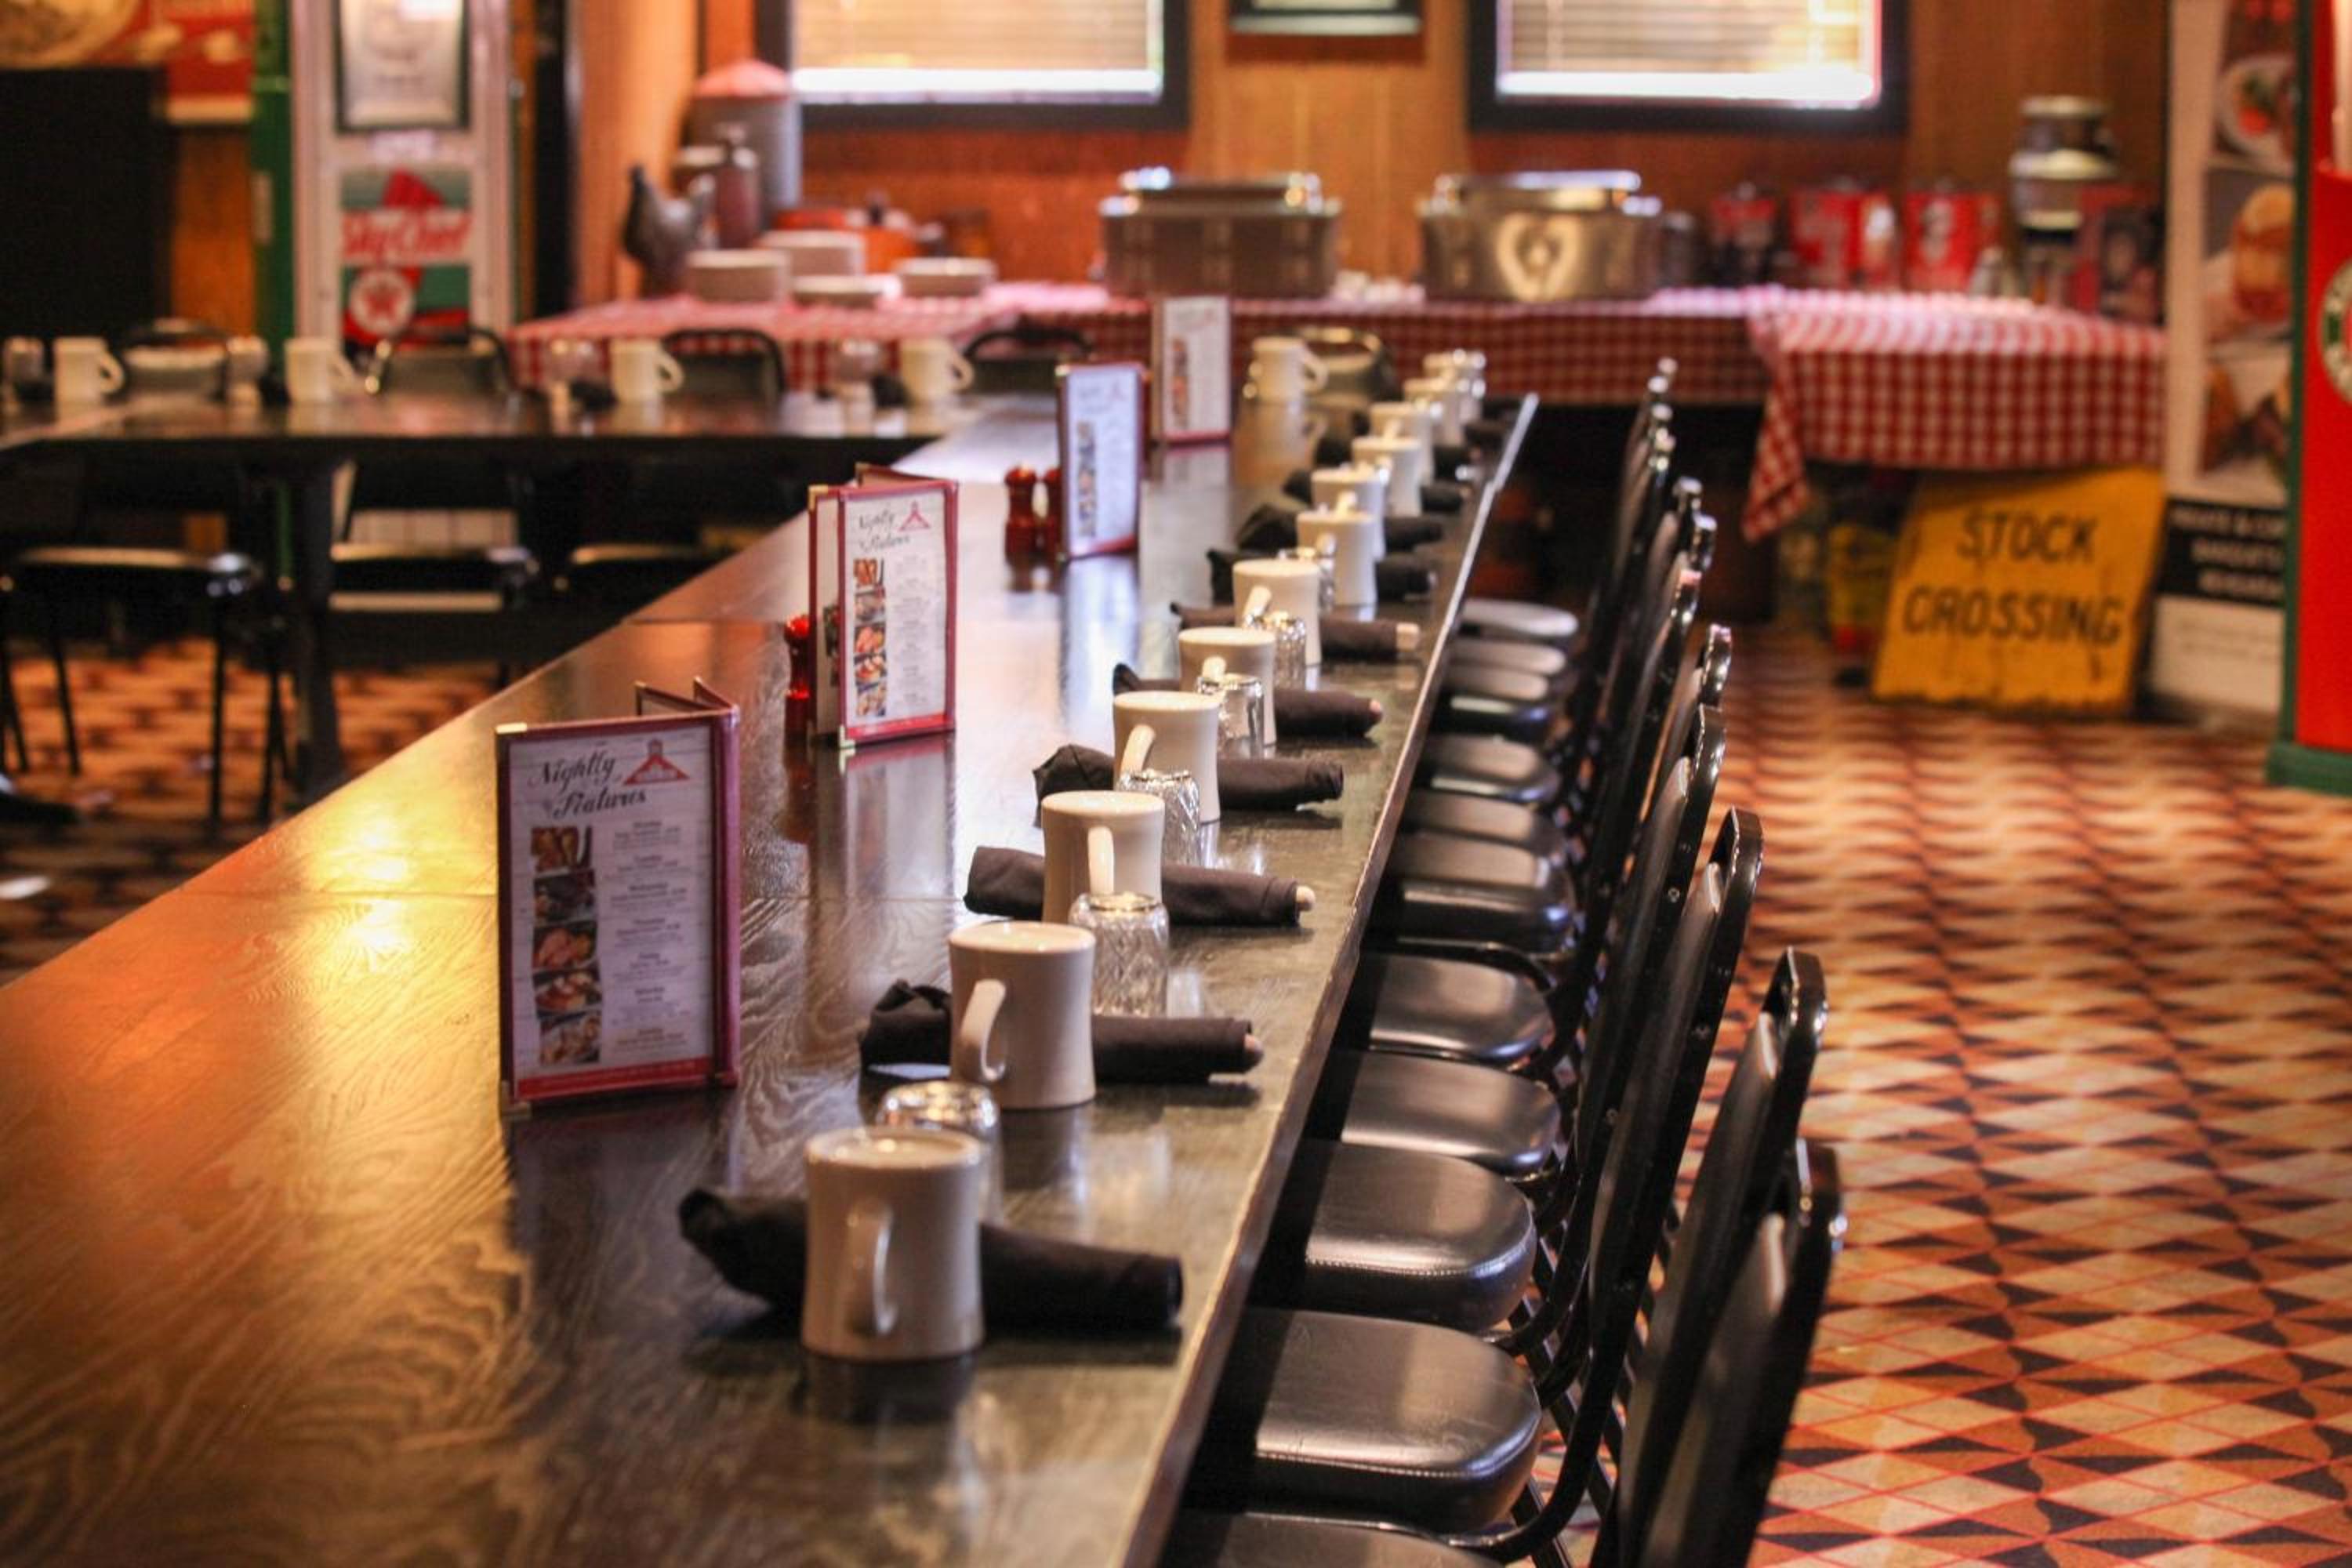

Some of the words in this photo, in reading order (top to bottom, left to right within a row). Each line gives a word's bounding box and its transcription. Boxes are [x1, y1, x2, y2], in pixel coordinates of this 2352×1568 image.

[1958, 512, 2098, 562] STOCK
[1904, 585, 2123, 647] CROSSING
[528, 750, 616, 795] Nightly
[543, 786, 647, 820] Features
